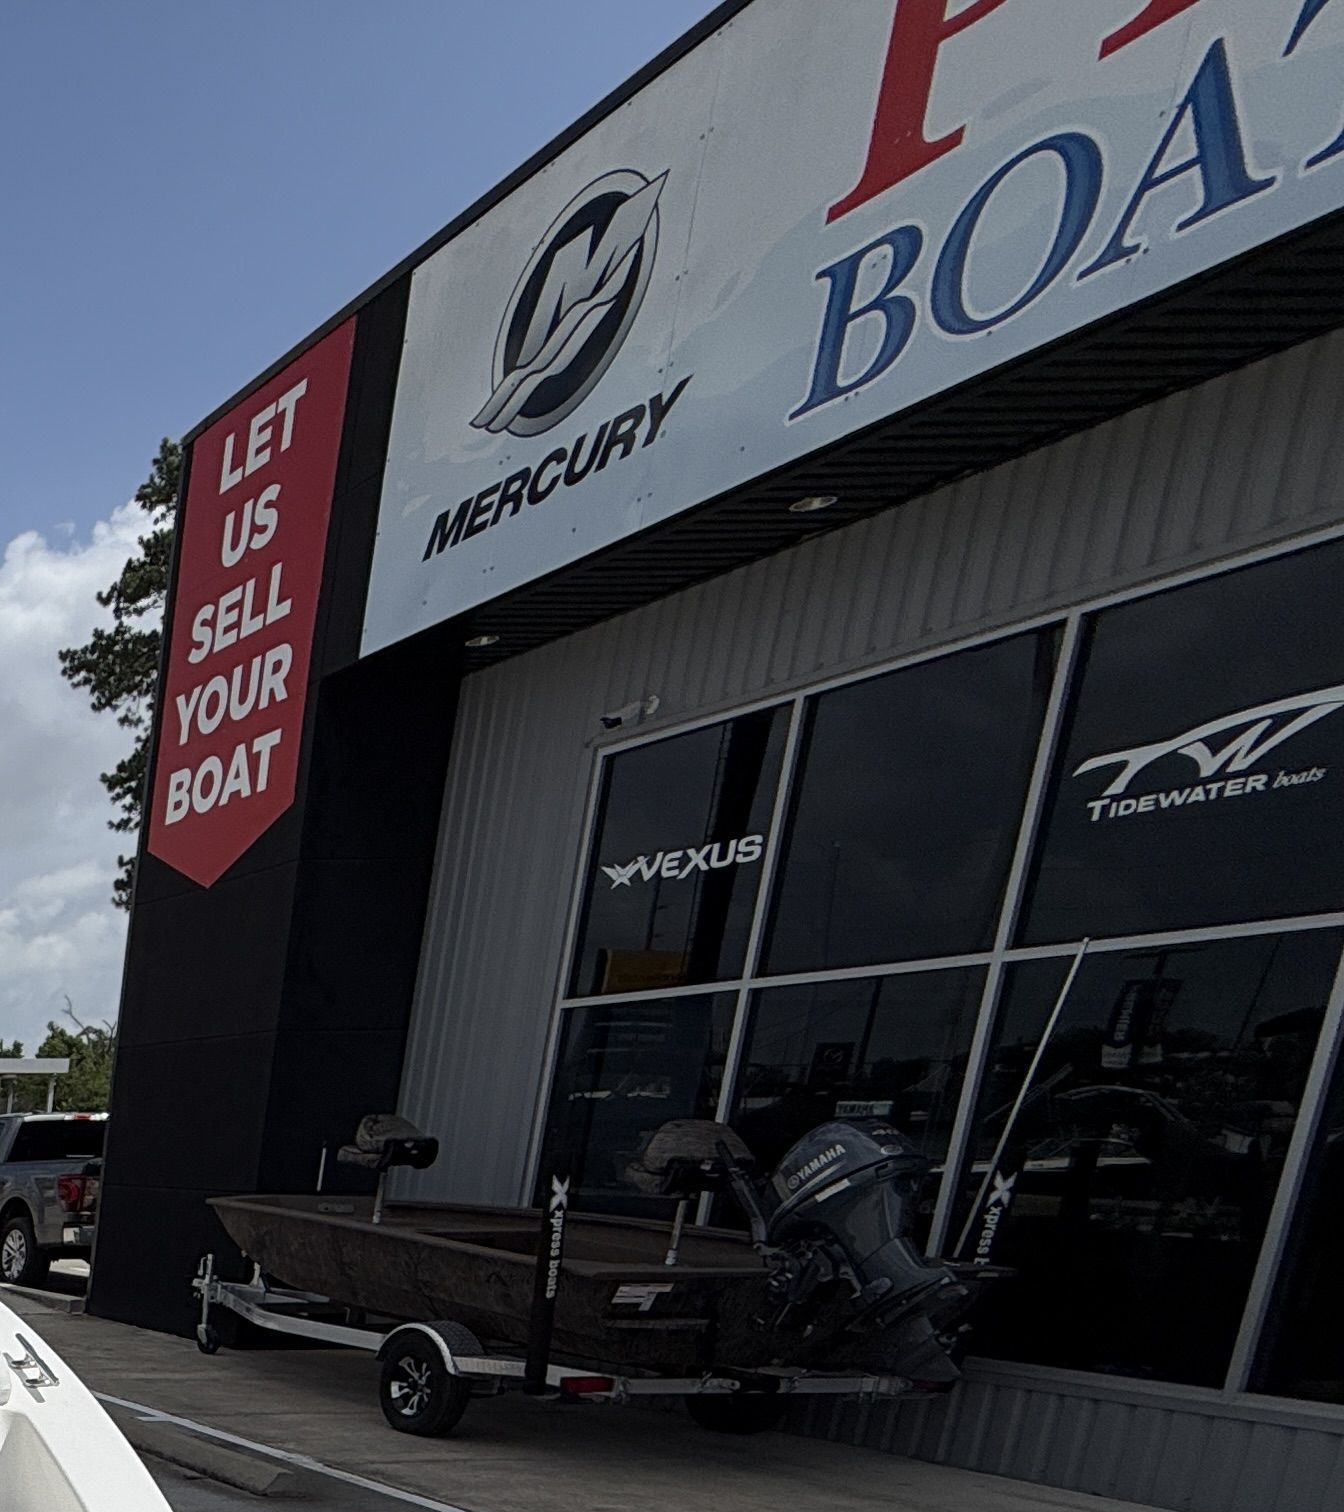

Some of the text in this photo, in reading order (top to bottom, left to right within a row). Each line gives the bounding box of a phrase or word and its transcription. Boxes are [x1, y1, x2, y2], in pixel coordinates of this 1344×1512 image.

[219, 379, 307, 494] LET
[422, 373, 694, 562] MERCURY
[220, 483, 281, 568] US
[188, 562, 292, 664] SELL
[174, 643, 292, 746] YOUR
[164, 728, 281, 825] BOAT
[1087, 767, 1327, 822] TIDEWATER boats
[637, 835, 763, 882] VEXUS
[797, 1144, 846, 1180] YAMAHA
[550, 1210, 564, 1257] xpress
[977, 1206, 1003, 1254] xpress
[545, 1260, 560, 1299] boats
